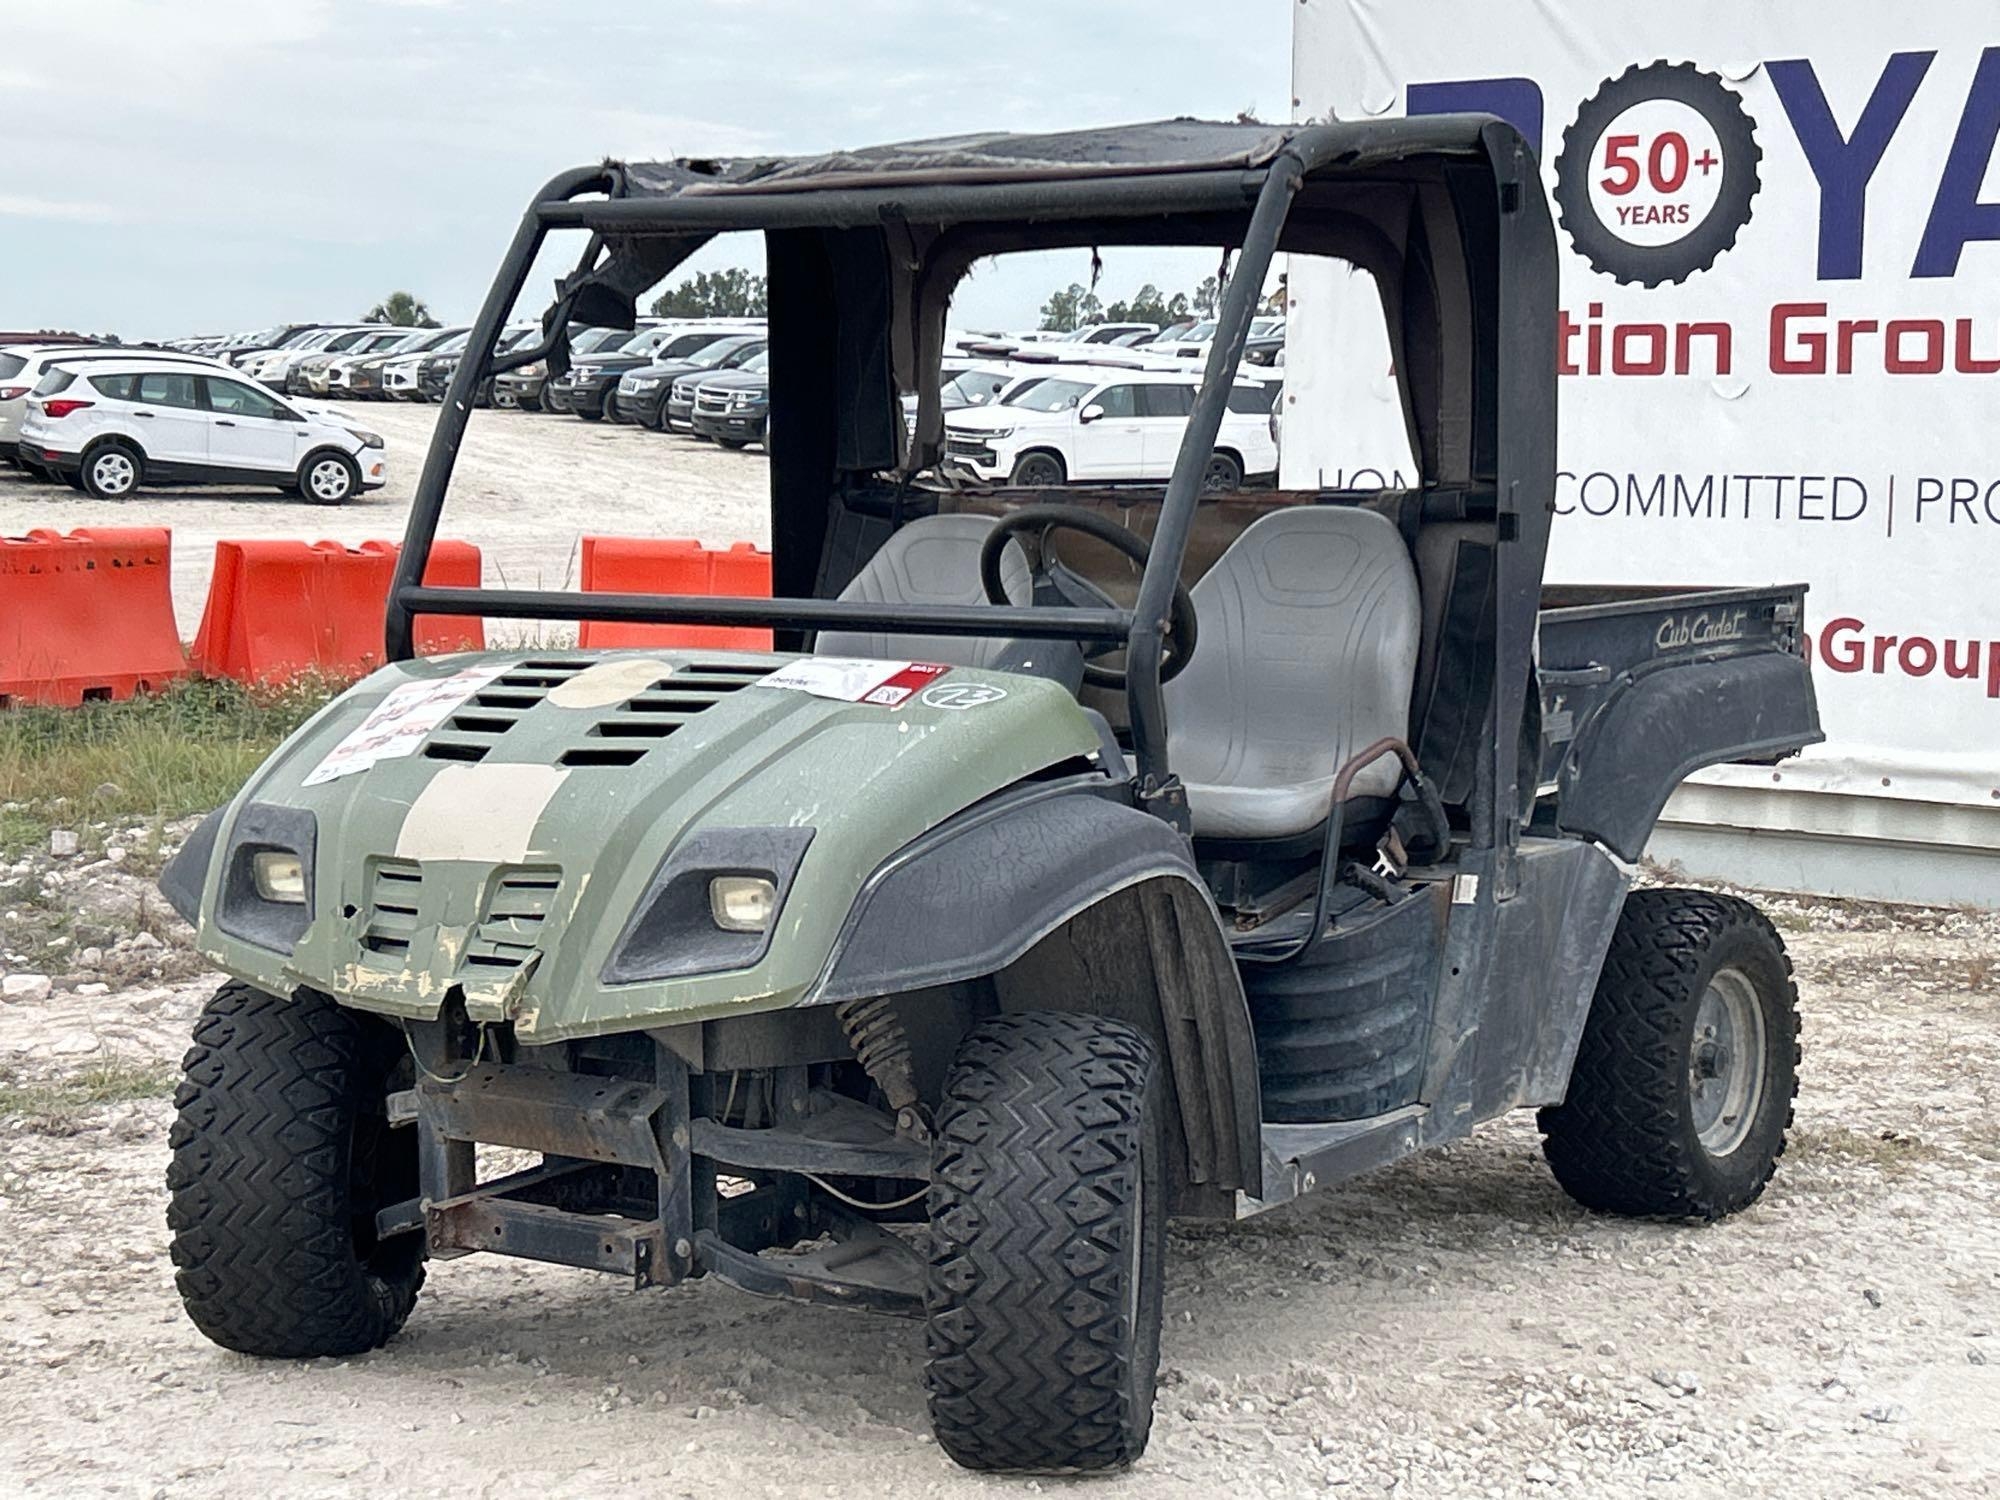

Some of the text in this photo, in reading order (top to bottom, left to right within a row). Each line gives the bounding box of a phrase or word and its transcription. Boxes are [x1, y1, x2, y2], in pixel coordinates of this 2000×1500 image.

[1600, 131, 1719, 196] 50+
[1616, 203, 1690, 226] YEARS
[1553, 471, 1868, 521] COMMITTED
[1656, 609, 1748, 649] Cub Cadet
